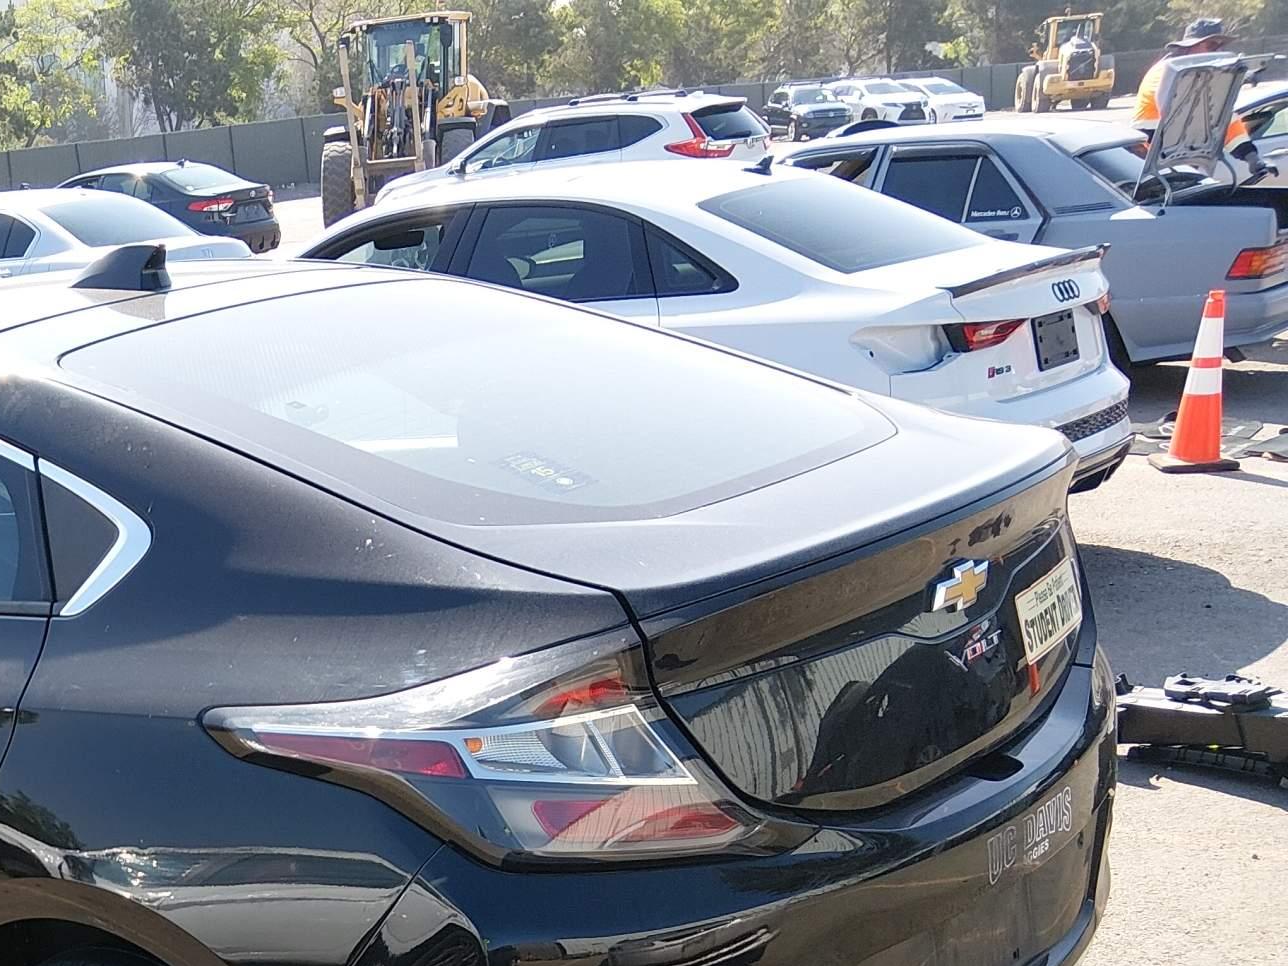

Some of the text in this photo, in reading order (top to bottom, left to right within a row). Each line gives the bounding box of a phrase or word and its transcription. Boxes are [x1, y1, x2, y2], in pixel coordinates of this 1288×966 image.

[944, 629, 1002, 672] VOLT
[1024, 600, 1060, 653] STUDENT
[987, 786, 1072, 886] UC DAVIS
